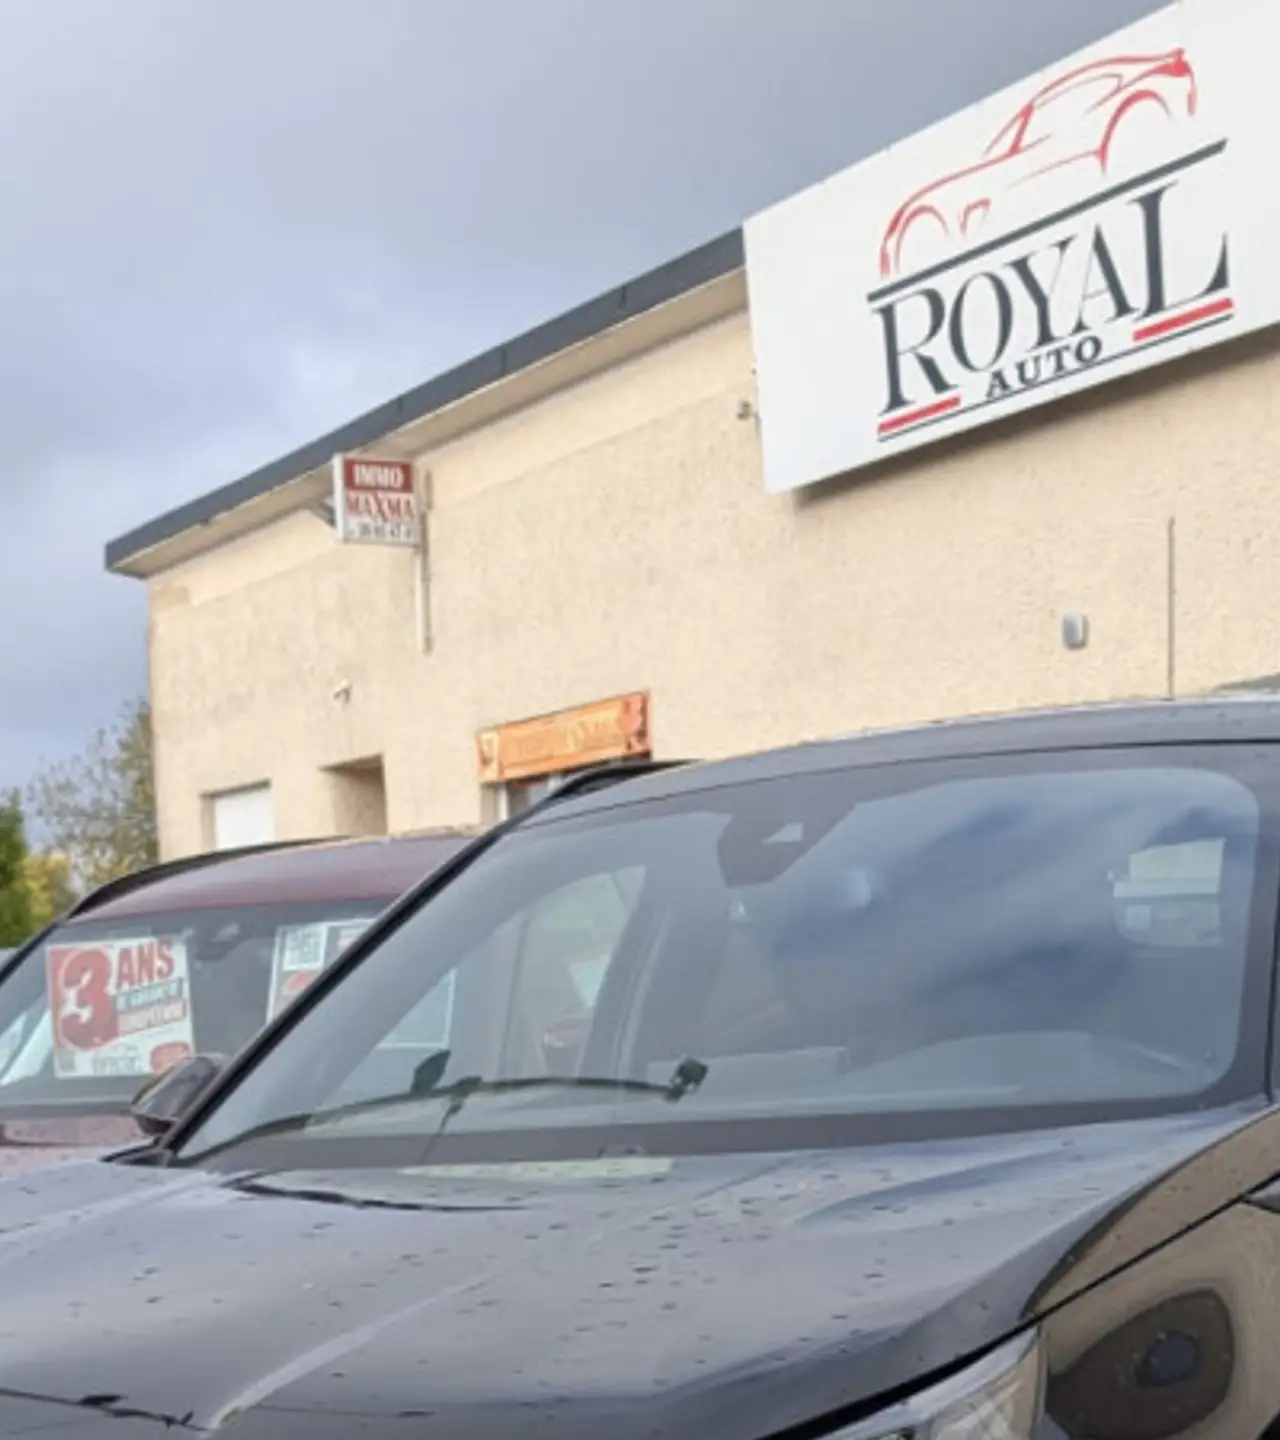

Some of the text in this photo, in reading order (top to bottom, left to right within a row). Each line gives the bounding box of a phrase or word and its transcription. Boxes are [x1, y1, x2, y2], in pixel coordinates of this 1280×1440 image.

[873, 180, 1230, 416] ROYAL
[986, 335, 1103, 398] AUTO
[61, 948, 114, 1050] 3
[117, 938, 175, 987] ANS
